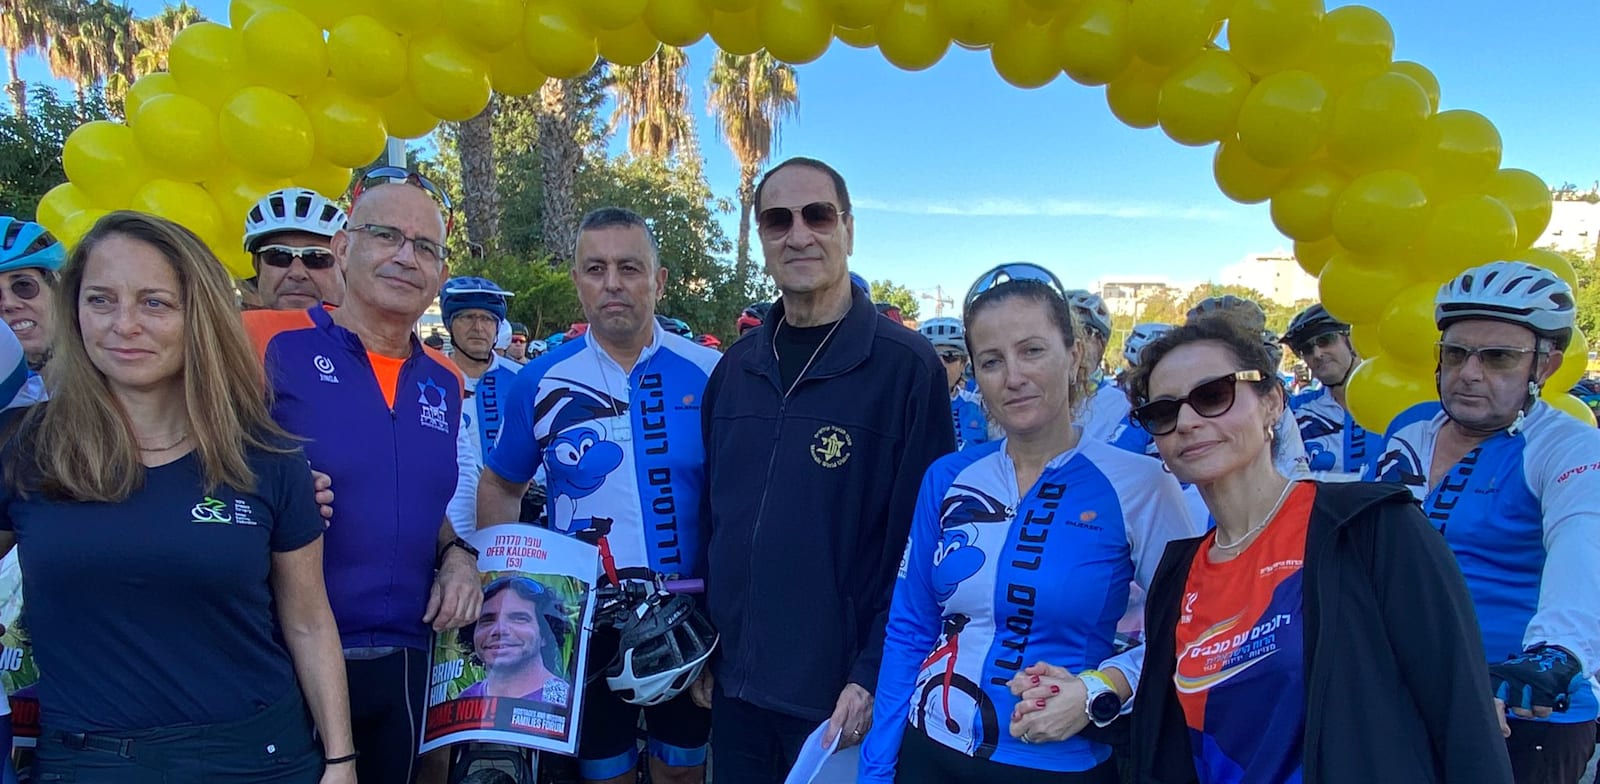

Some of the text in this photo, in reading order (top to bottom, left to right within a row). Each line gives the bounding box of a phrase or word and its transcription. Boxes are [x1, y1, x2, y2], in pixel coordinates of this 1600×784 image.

[639, 373, 682, 565] דרדסים רוכבים
[1012, 482, 1067, 571] רוכבים
[524, 536, 542, 548] עופר
[486, 547, 548, 560] OFER KALDERON
[506, 557, 522, 568] (53)
[1232, 630, 1250, 648] עם
[432, 659, 464, 686] BRING
[430, 681, 448, 708] HIM
[456, 697, 498, 721] NOW!
[511, 714, 565, 734] FAMILIES FORUM
